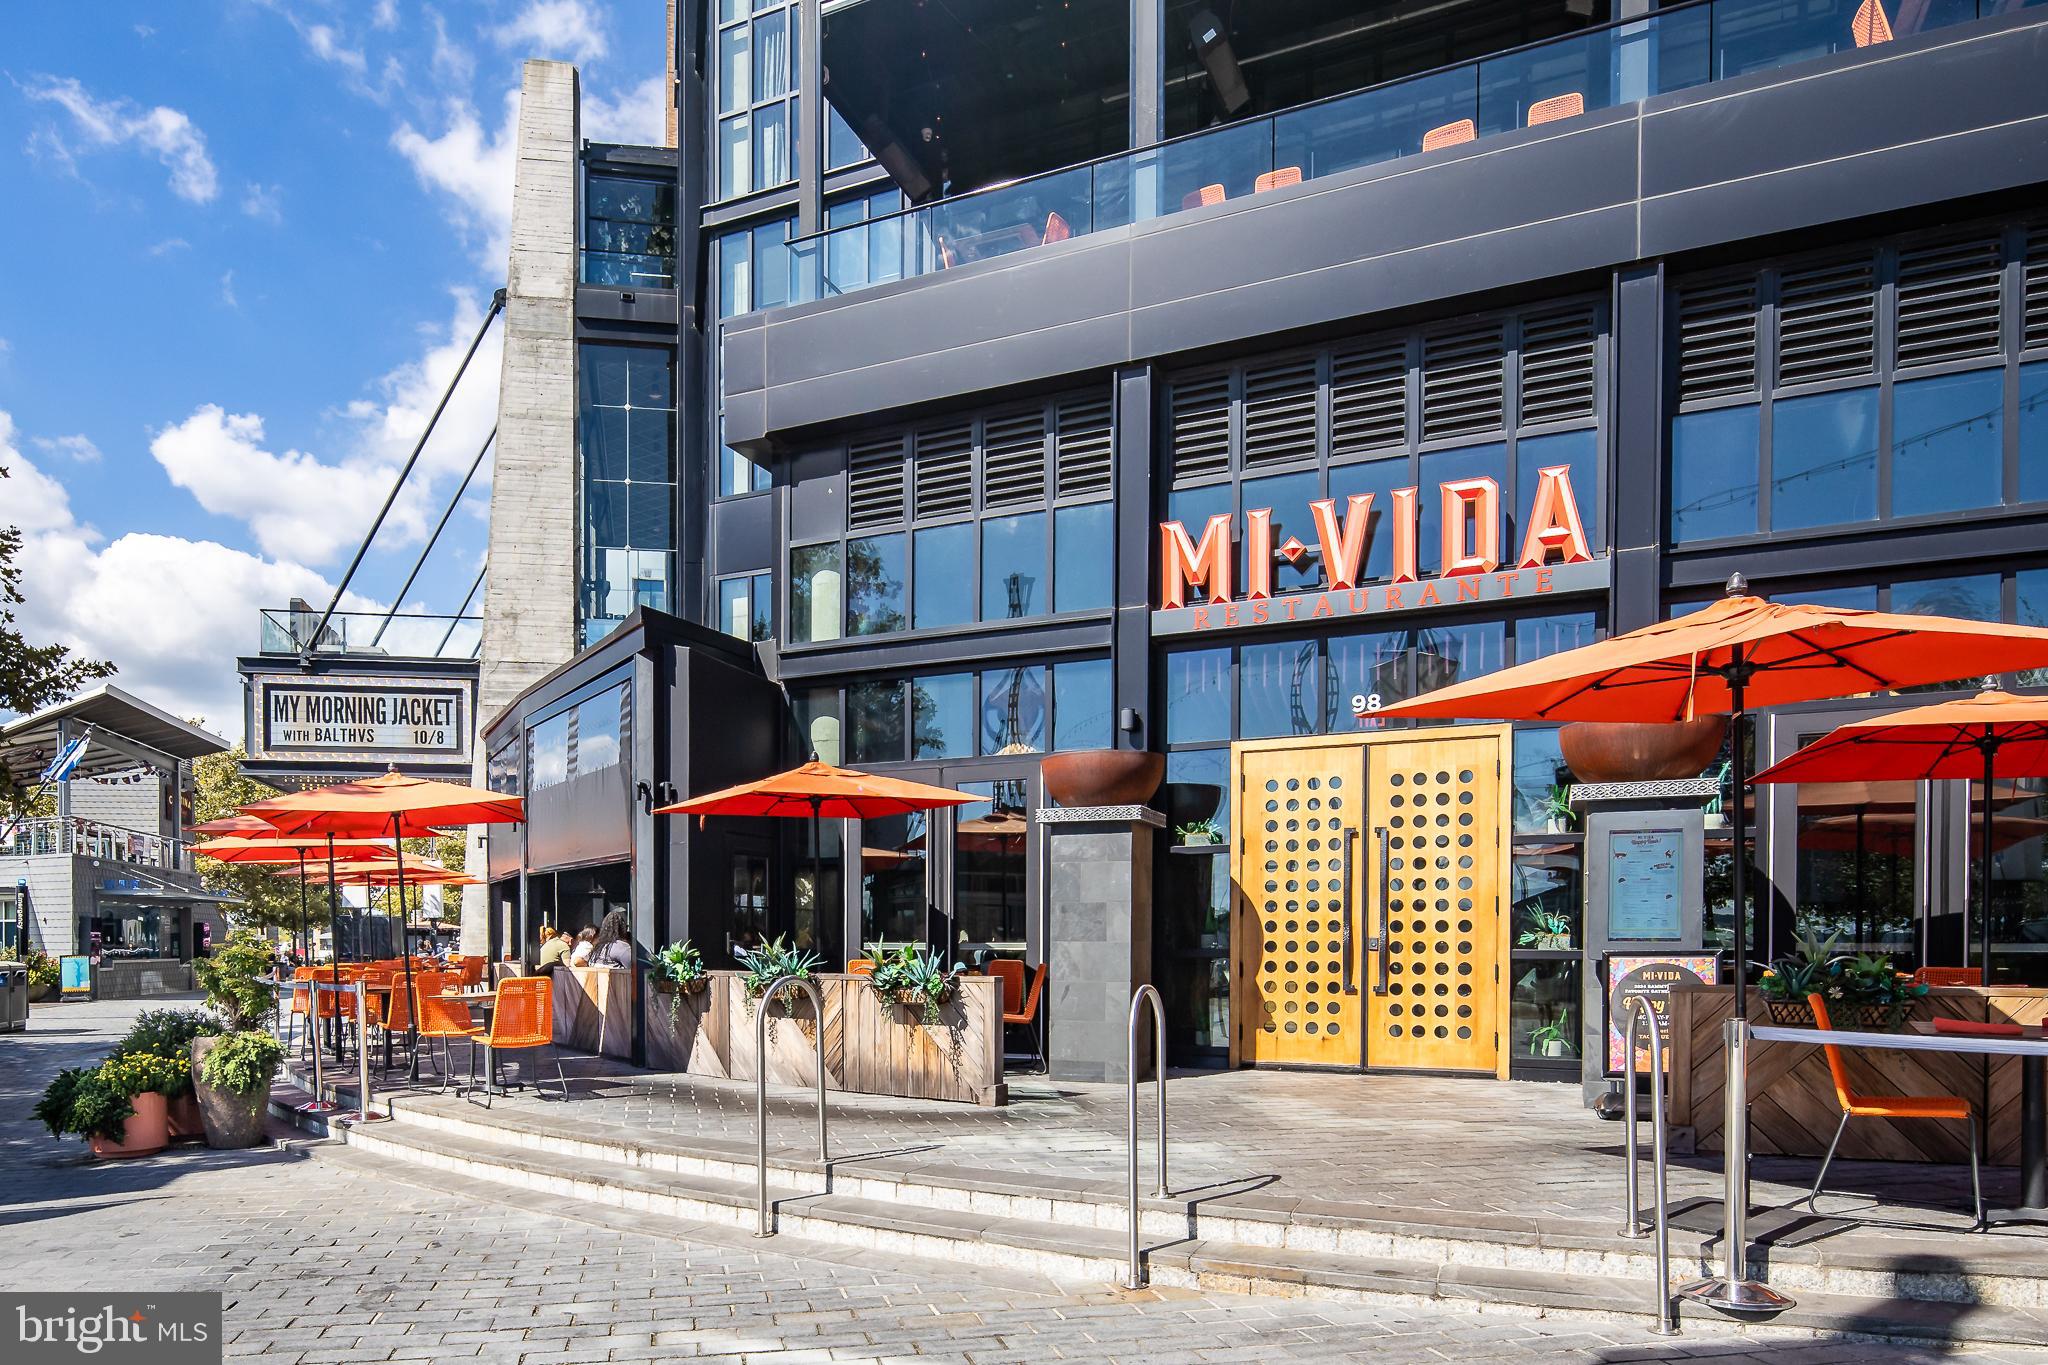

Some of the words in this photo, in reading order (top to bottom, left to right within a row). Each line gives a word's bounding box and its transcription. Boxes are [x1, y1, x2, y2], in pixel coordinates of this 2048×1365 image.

[1193, 568, 1554, 630] RESTAURANTE
[273, 695, 300, 723] MY
[305, 696, 387, 725] MORNING
[391, 698, 453, 726] JACKET
[1351, 693, 1382, 713] 98
[283, 729, 310, 742] WITH
[314, 728, 375, 743] BALTHVS
[413, 730, 445, 745] 10/8
[16, 892, 25, 930] Emergency
